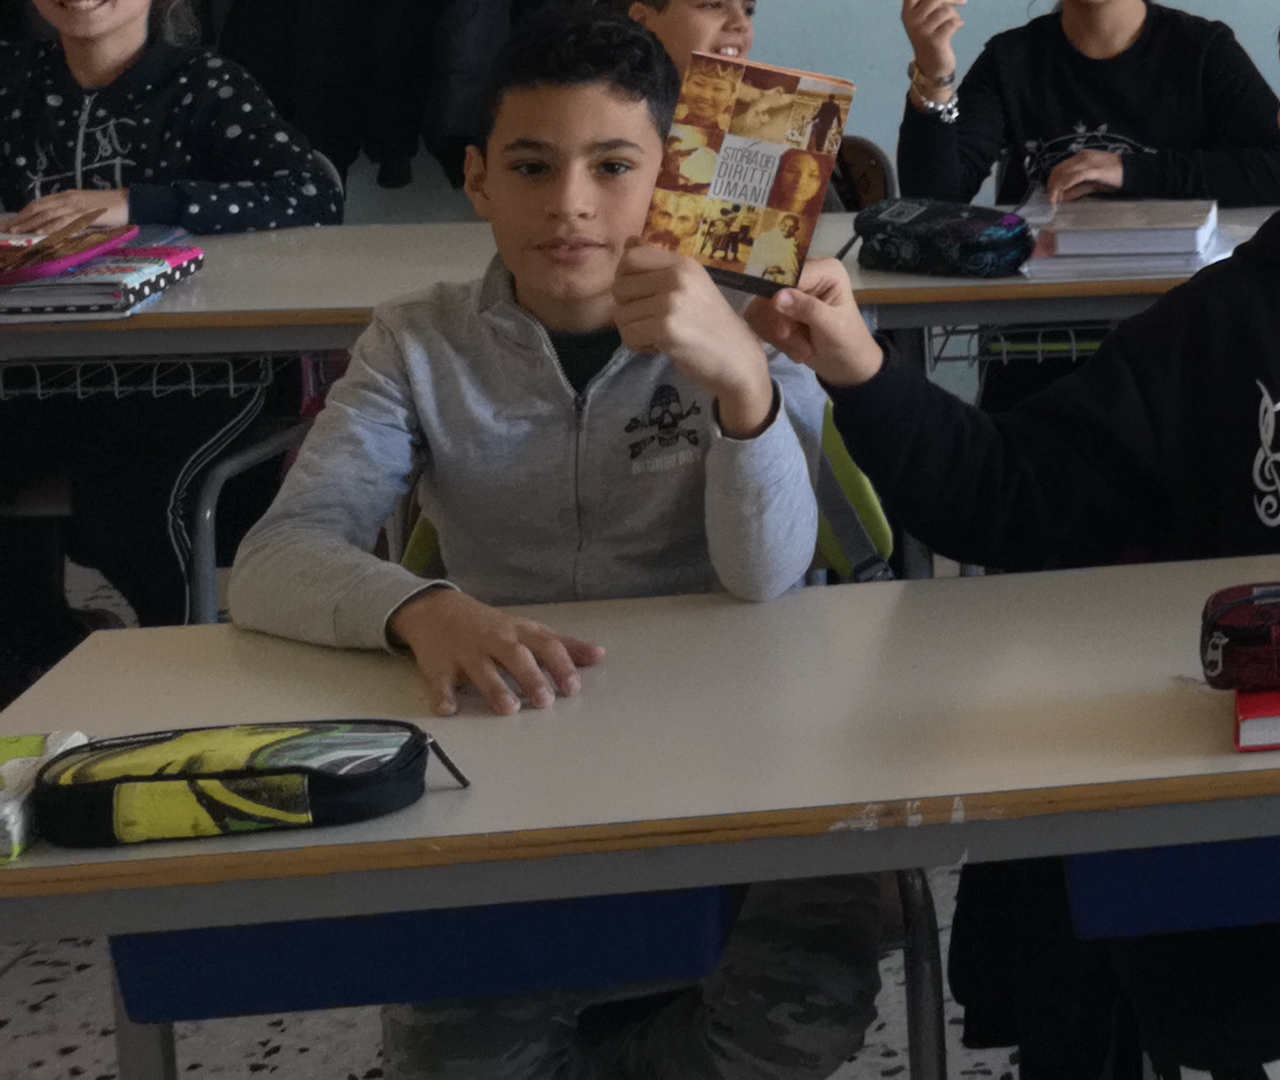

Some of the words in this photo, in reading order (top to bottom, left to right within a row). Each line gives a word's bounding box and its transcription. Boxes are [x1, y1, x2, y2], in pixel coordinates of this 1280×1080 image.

[722, 146, 761, 167] STORIA
[717, 161, 773, 187] DIRITTI
[712, 179, 768, 205] UMANI
